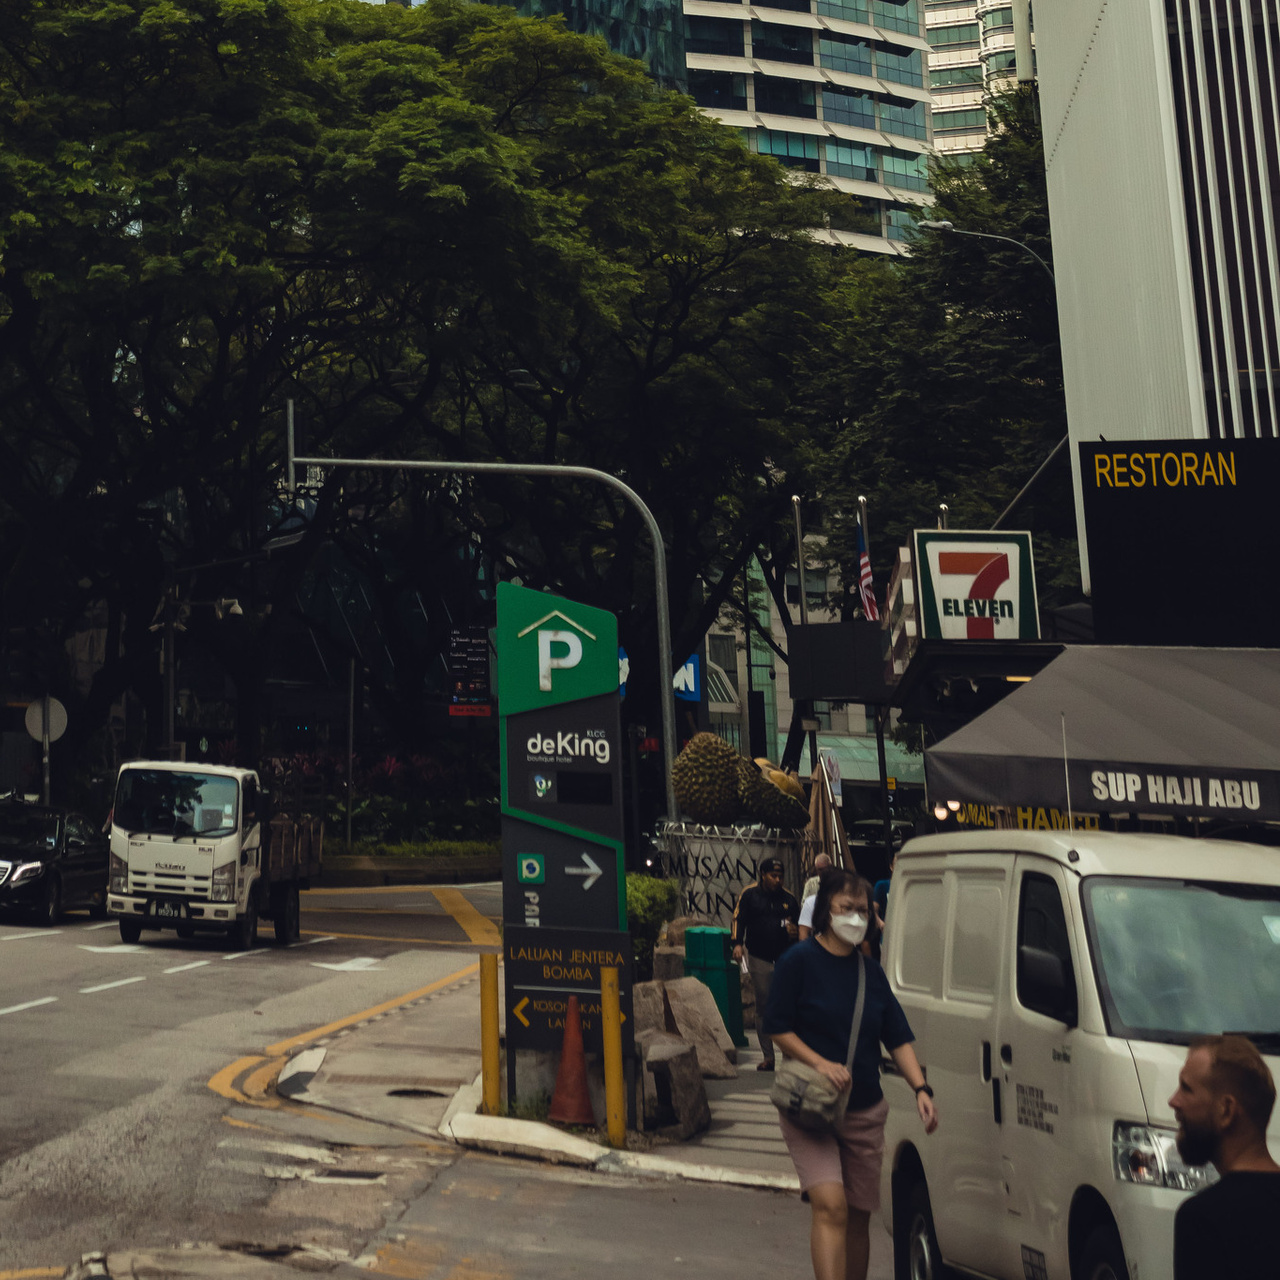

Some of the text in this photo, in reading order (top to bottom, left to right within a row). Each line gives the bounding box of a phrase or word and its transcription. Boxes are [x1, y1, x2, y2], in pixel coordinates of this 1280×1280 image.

[1094, 451, 1237, 488] RESTORAN
[938, 552, 1010, 639] 7
[537, 629, 583, 692] P
[527, 730, 610, 765] deKing
[555, 755, 573, 764] hotel
[1091, 770, 1261, 811] SUP HAJI ABU
[669, 855, 758, 881] MUSAN
[687, 890, 736, 916] KIN
[510, 946, 625, 966] LALUAN JENTERA
[543, 964, 593, 982] BOMBA
